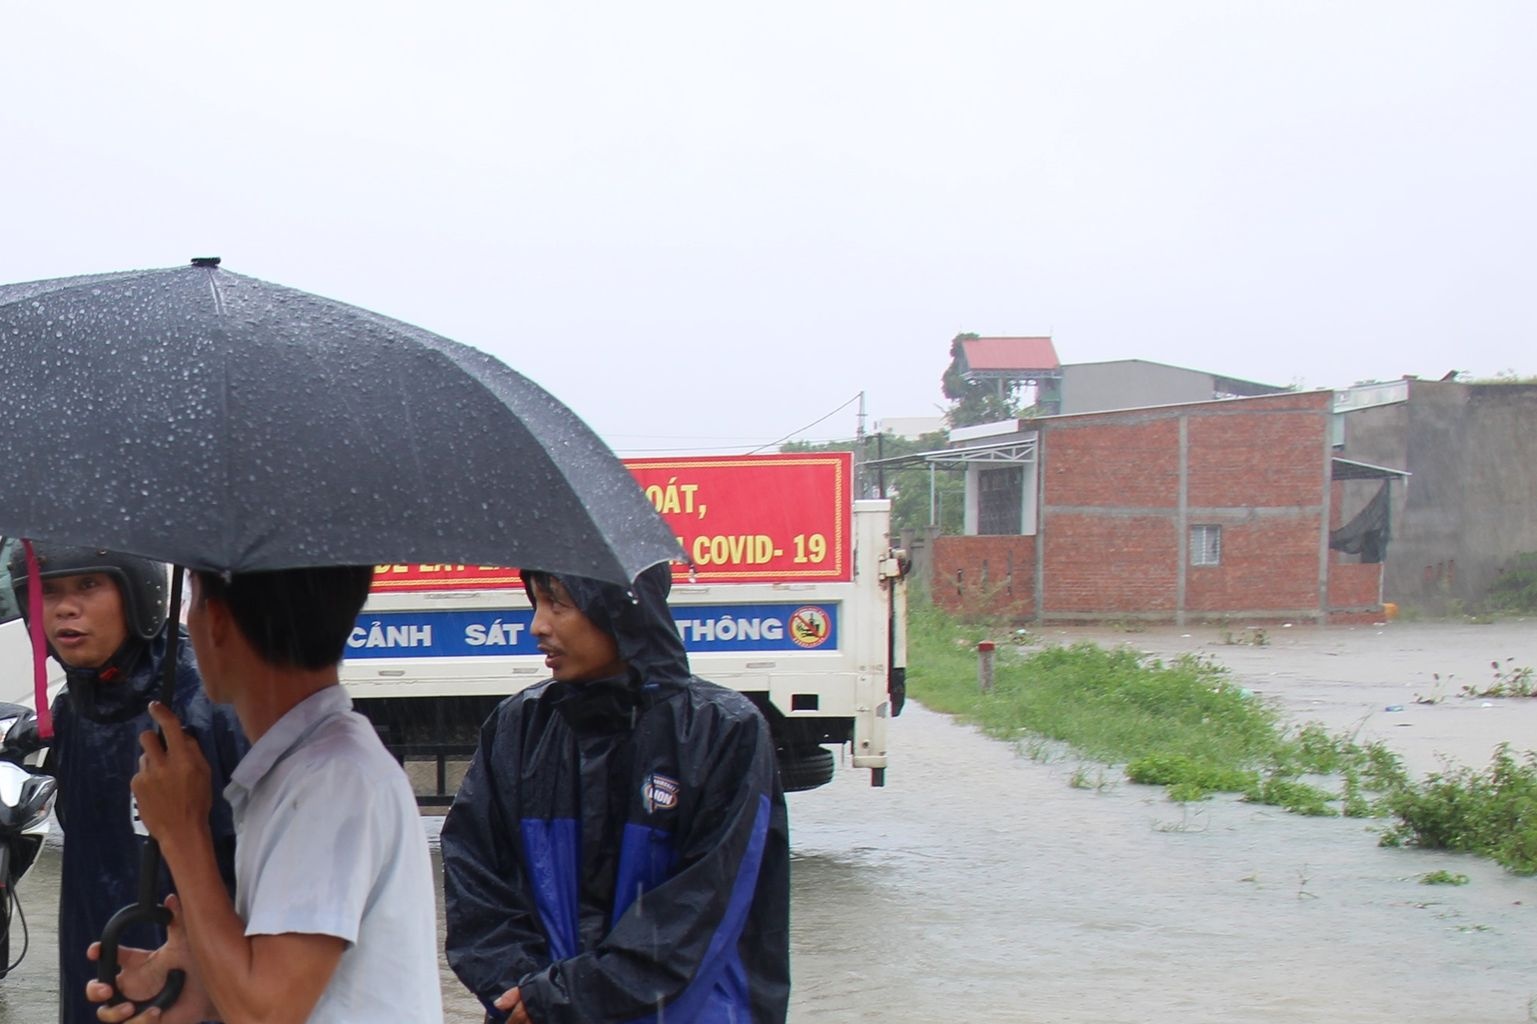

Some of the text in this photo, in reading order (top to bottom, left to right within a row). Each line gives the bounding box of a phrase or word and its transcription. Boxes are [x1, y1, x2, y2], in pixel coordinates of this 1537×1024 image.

[645, 476, 707, 519] OÁT,
[793, 533, 826, 563] 19
[346, 621, 432, 648] CẢNH
[464, 618, 525, 646] SÁT
[674, 614, 783, 642] THÔNG
